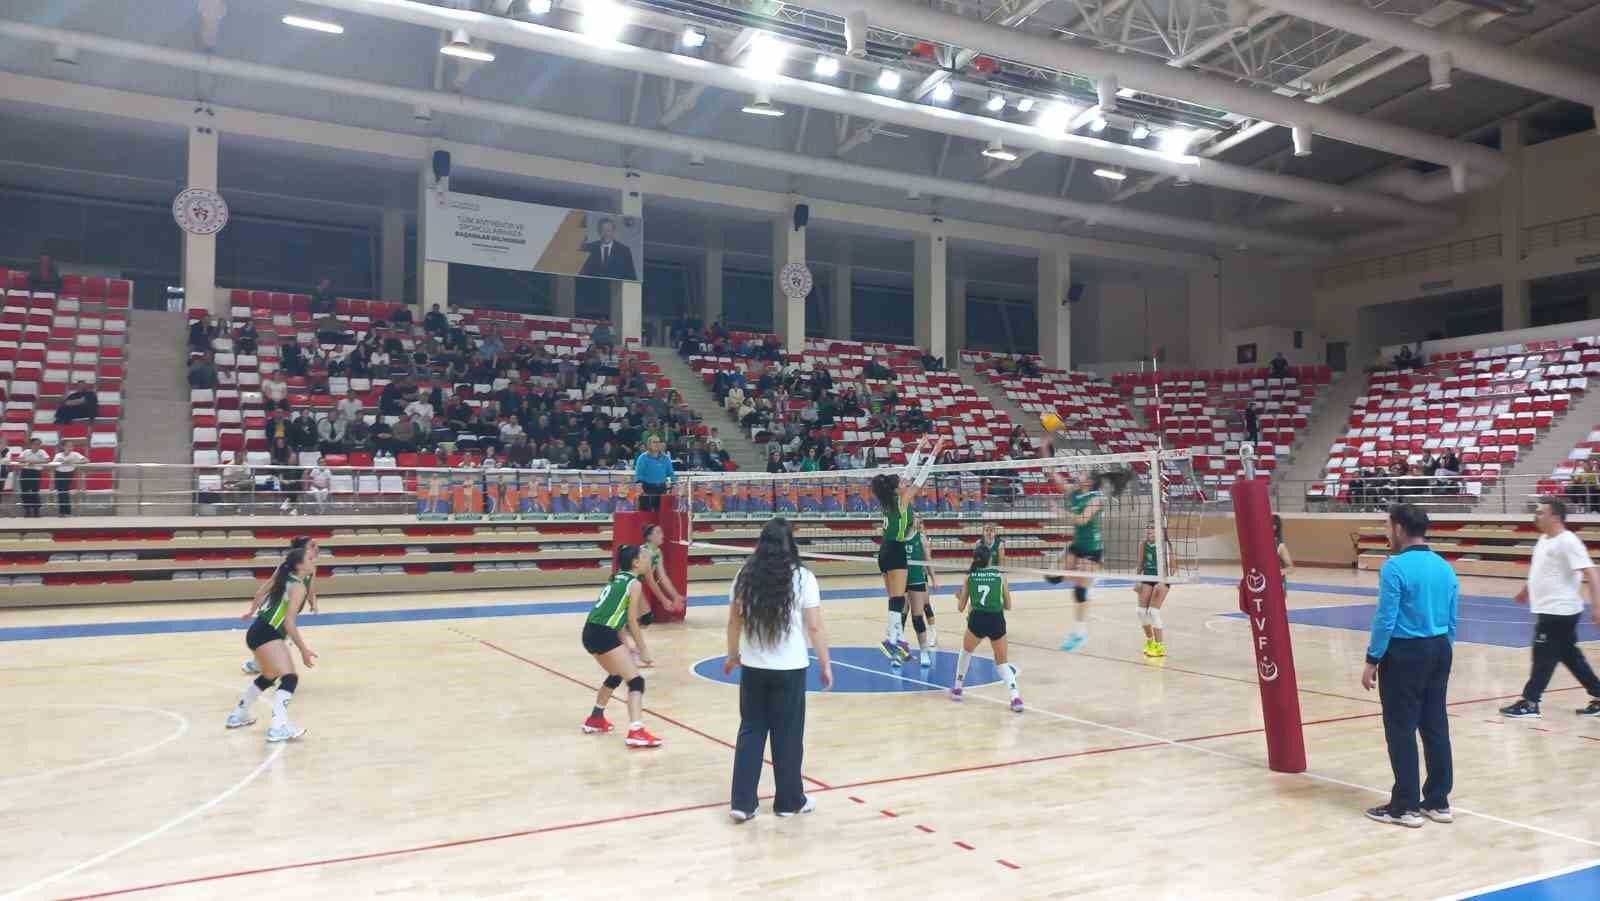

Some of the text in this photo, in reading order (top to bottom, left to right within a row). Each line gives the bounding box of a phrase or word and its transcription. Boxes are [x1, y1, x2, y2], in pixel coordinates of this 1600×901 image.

[595, 585, 611, 608] 9
[977, 584, 991, 607] 7
[1253, 599, 1268, 650] TVF
